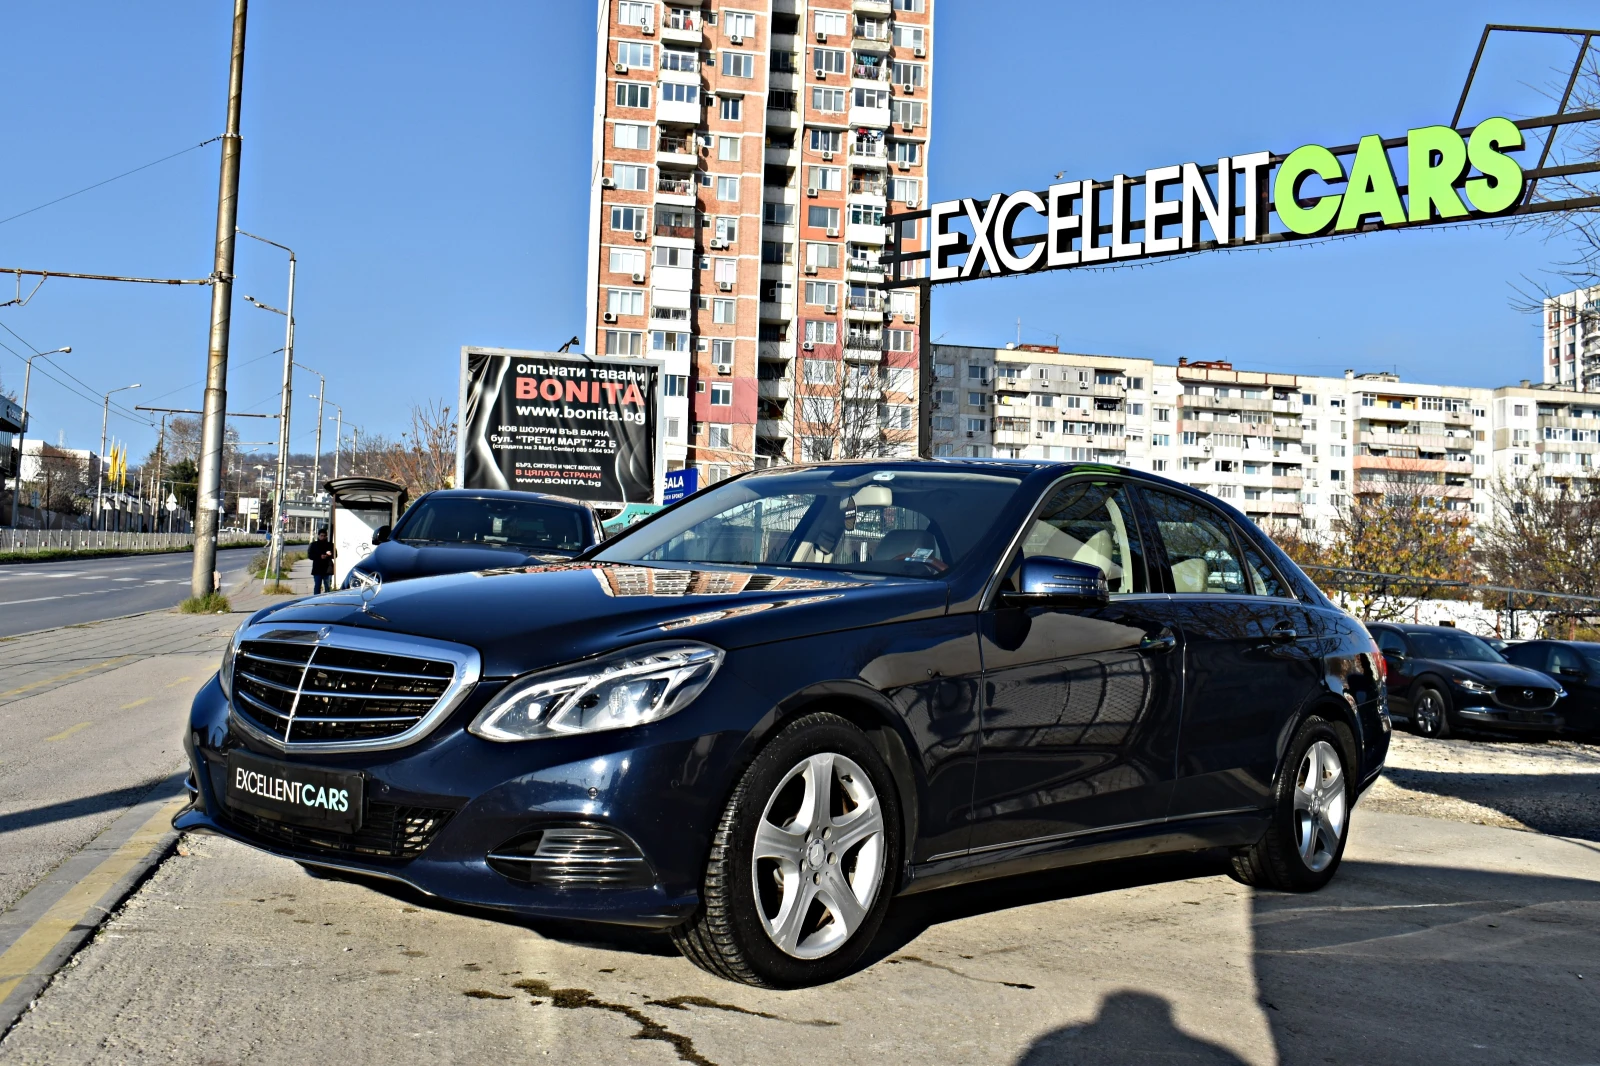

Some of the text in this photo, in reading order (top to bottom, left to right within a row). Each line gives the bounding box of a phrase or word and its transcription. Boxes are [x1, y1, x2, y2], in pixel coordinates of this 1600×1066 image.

[516, 363, 645, 382] опънати тавани
[515, 376, 645, 406] BONITA
[516, 405, 646, 425] www.bonita.bg
[519, 426, 557, 434] ШОУРУМ
[580, 429, 610, 437] ВАРНА
[490, 434, 513, 444] бул.
[594, 440, 606, 448] 22
[608, 440, 617, 448] Б
[562, 471, 601, 479] СТРАНА!
[516, 478, 601, 487] www.BONITA.bg
